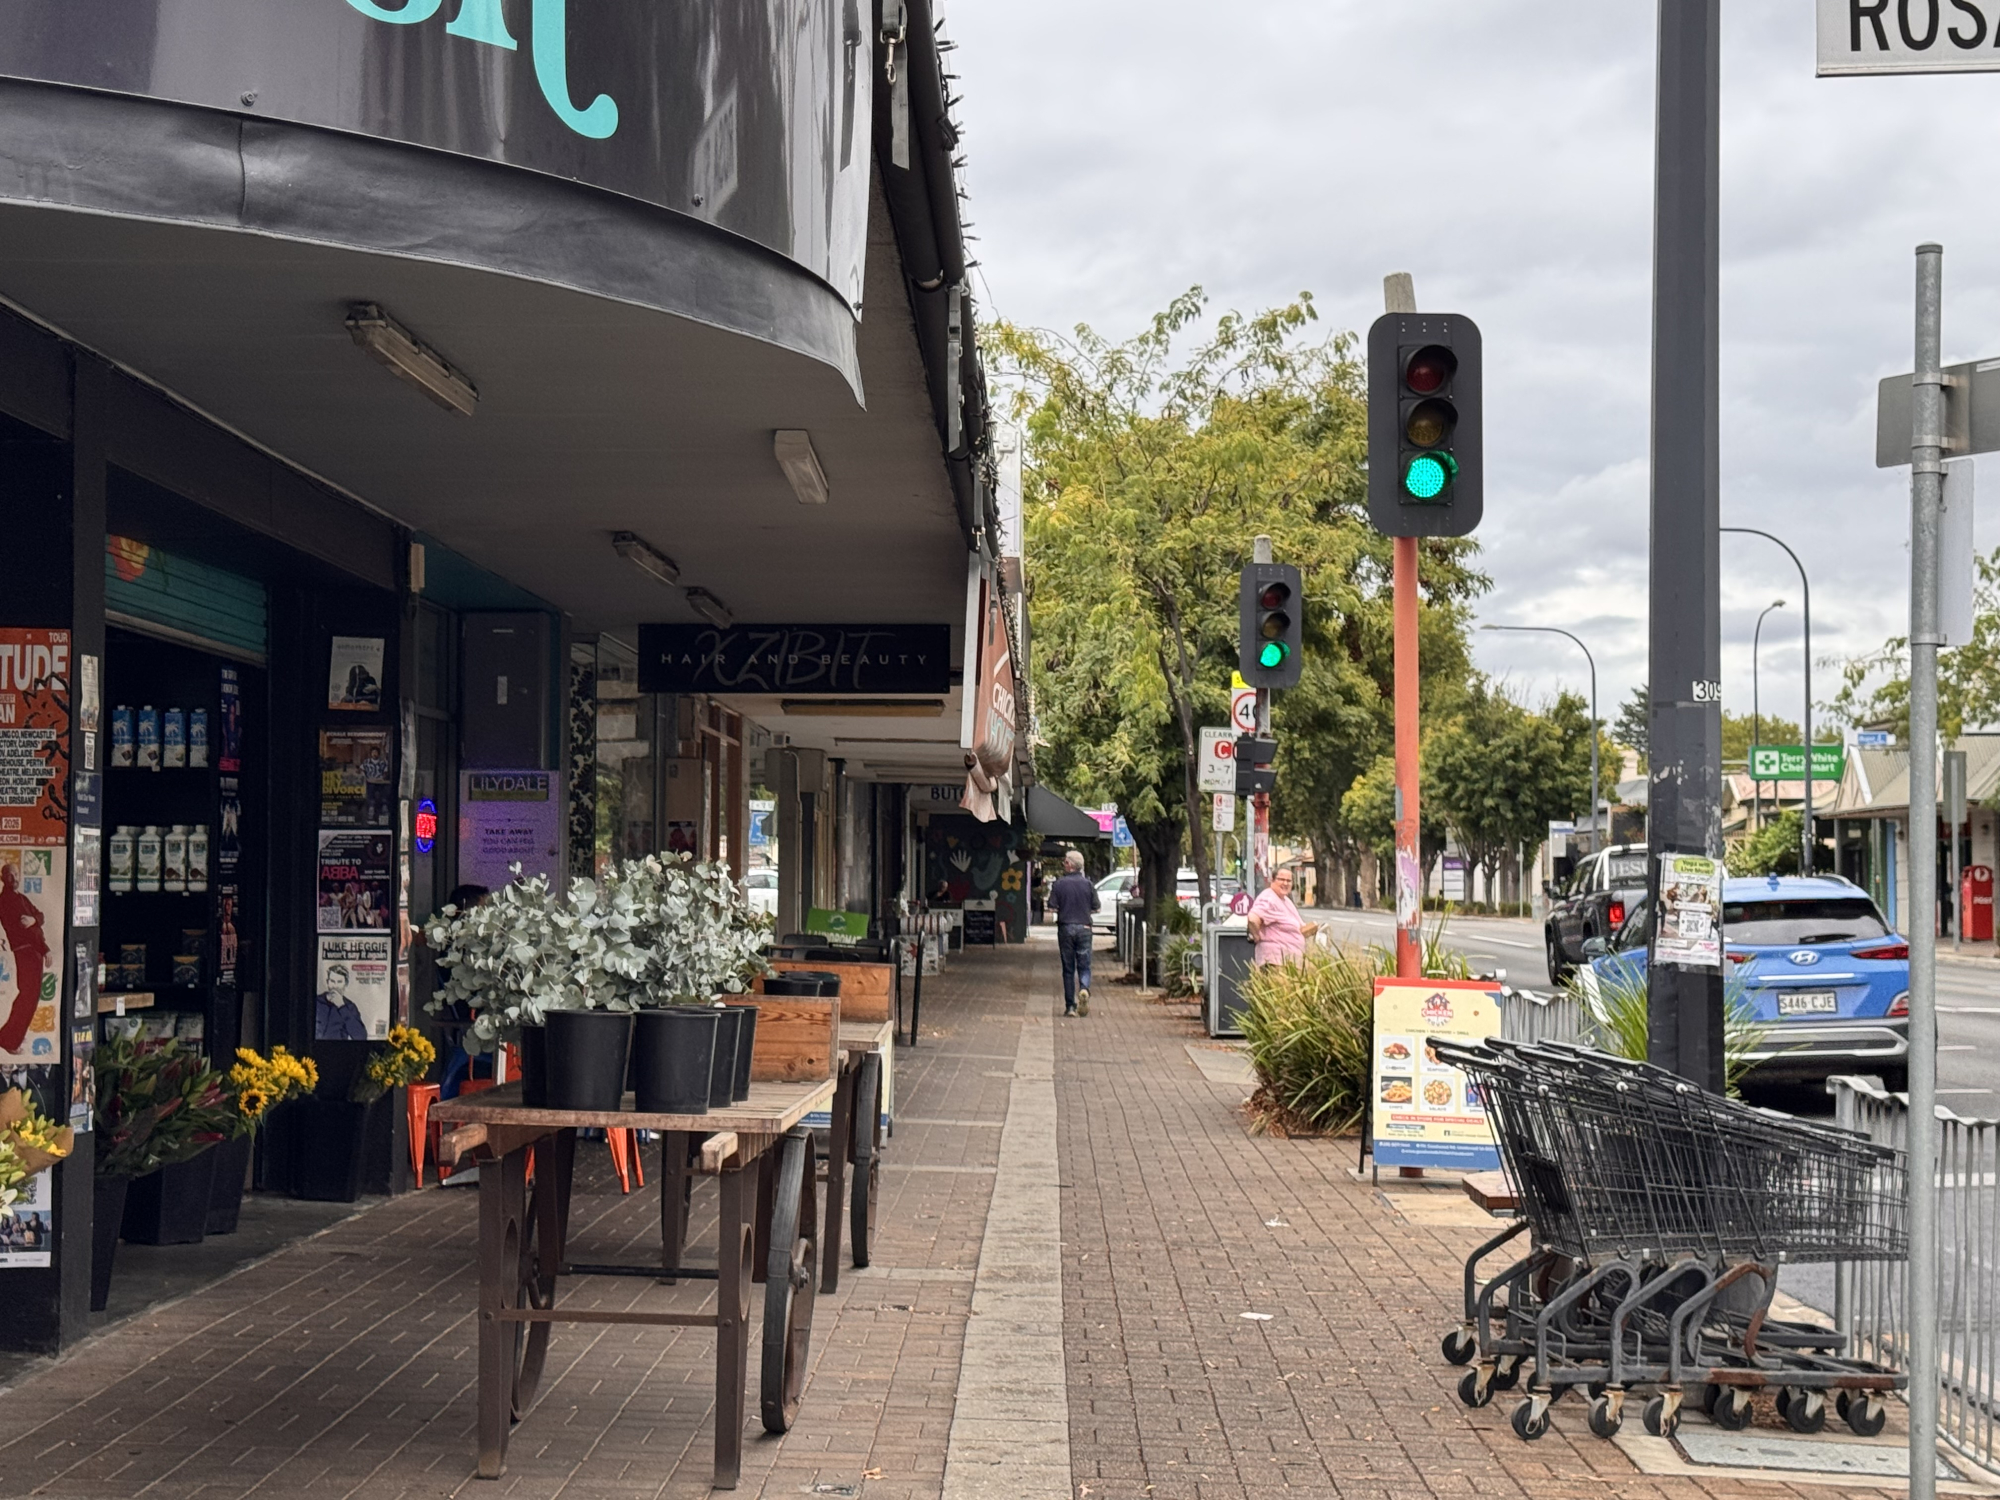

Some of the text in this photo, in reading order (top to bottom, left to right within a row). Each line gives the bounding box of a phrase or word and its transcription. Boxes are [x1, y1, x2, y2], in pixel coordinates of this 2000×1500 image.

[1850, 0, 2000, 51] ROS
[49, 632, 68, 643] TOUR
[661, 653, 927, 664] HAIR AND BEAUTY
[7, 749, 33, 758] ADELAIDE
[26, 758, 44, 767] PERTH
[22, 768, 54, 777] MELBOURNE
[13, 778, 34, 786] HOBART
[471, 777, 547, 791] LILYDALE
[21, 786, 41, 796] SYDNEY
[9, 796, 35, 805] BRISBANE
[320, 858, 362, 866] TRIBUTE TO
[320, 866, 359, 880] ABBA
[322, 941, 388, 952] LUKE HEGGIE
[347, 951, 360, 961] say
[1421, 1008, 1453, 1018] CHICKEN
